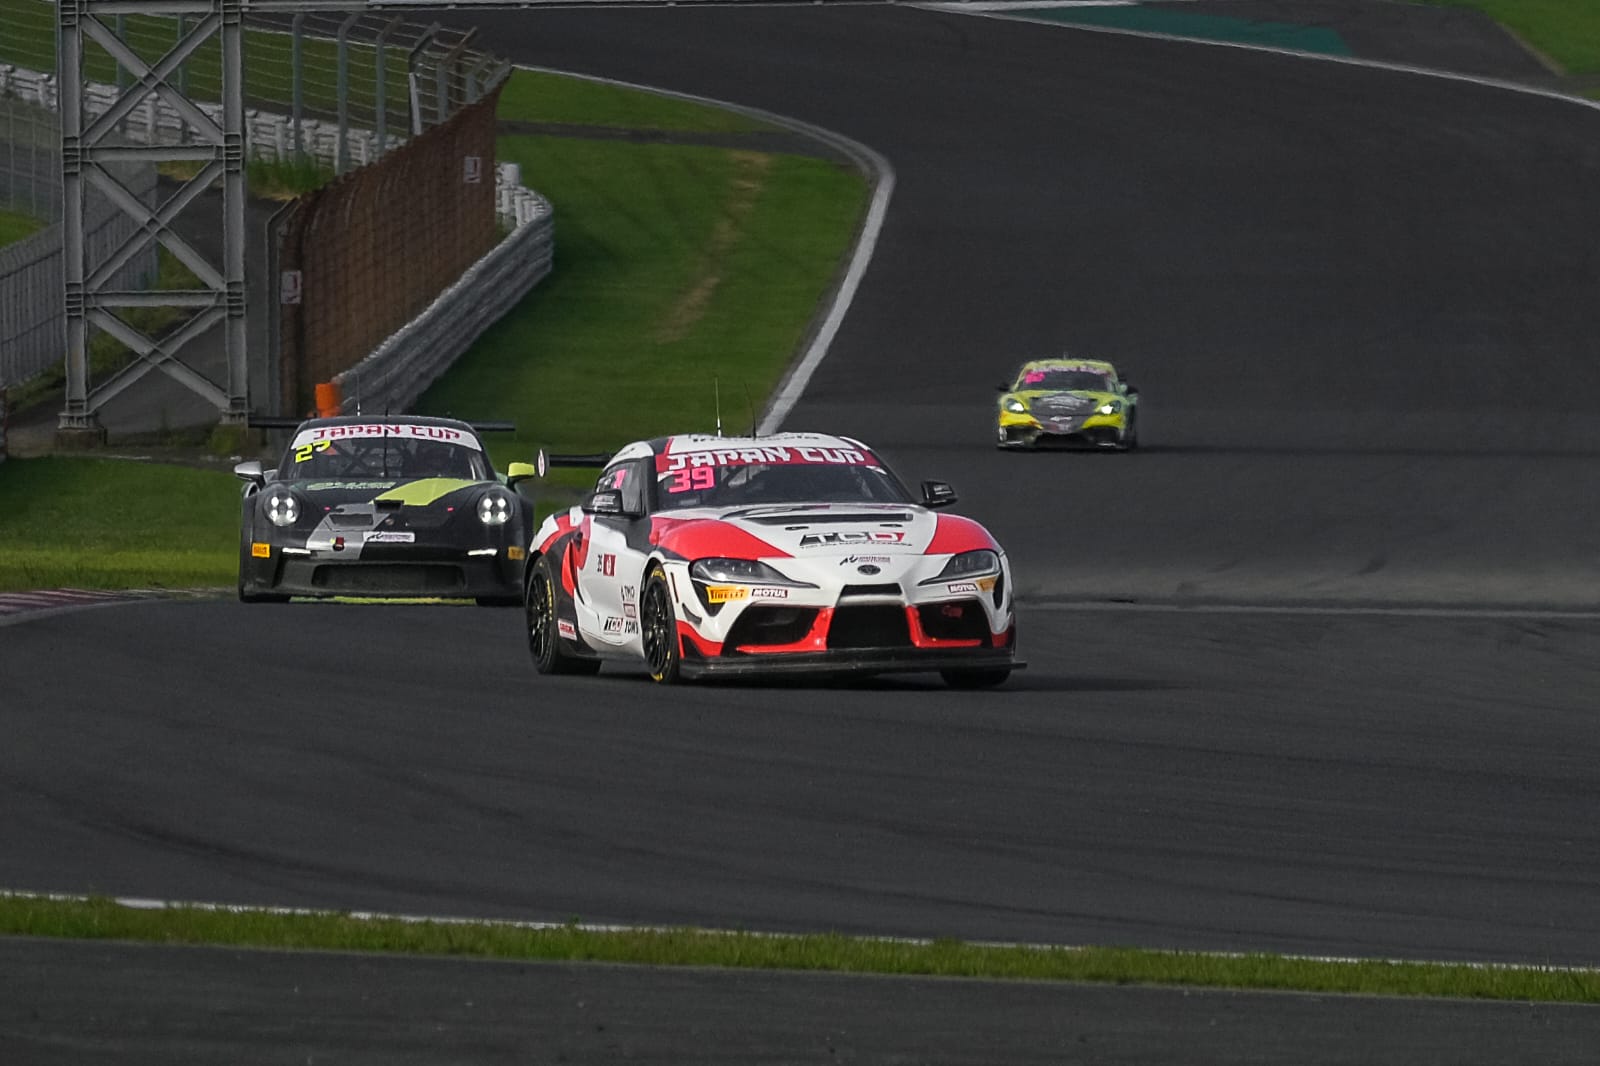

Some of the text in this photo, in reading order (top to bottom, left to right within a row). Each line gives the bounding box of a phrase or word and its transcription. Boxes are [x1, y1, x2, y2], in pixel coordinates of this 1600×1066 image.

[313, 425, 460, 440] JAPAN CUP
[668, 447, 865, 470] JAPAN CUP
[668, 467, 715, 493] 39
[752, 588, 788, 598] MOTUL
